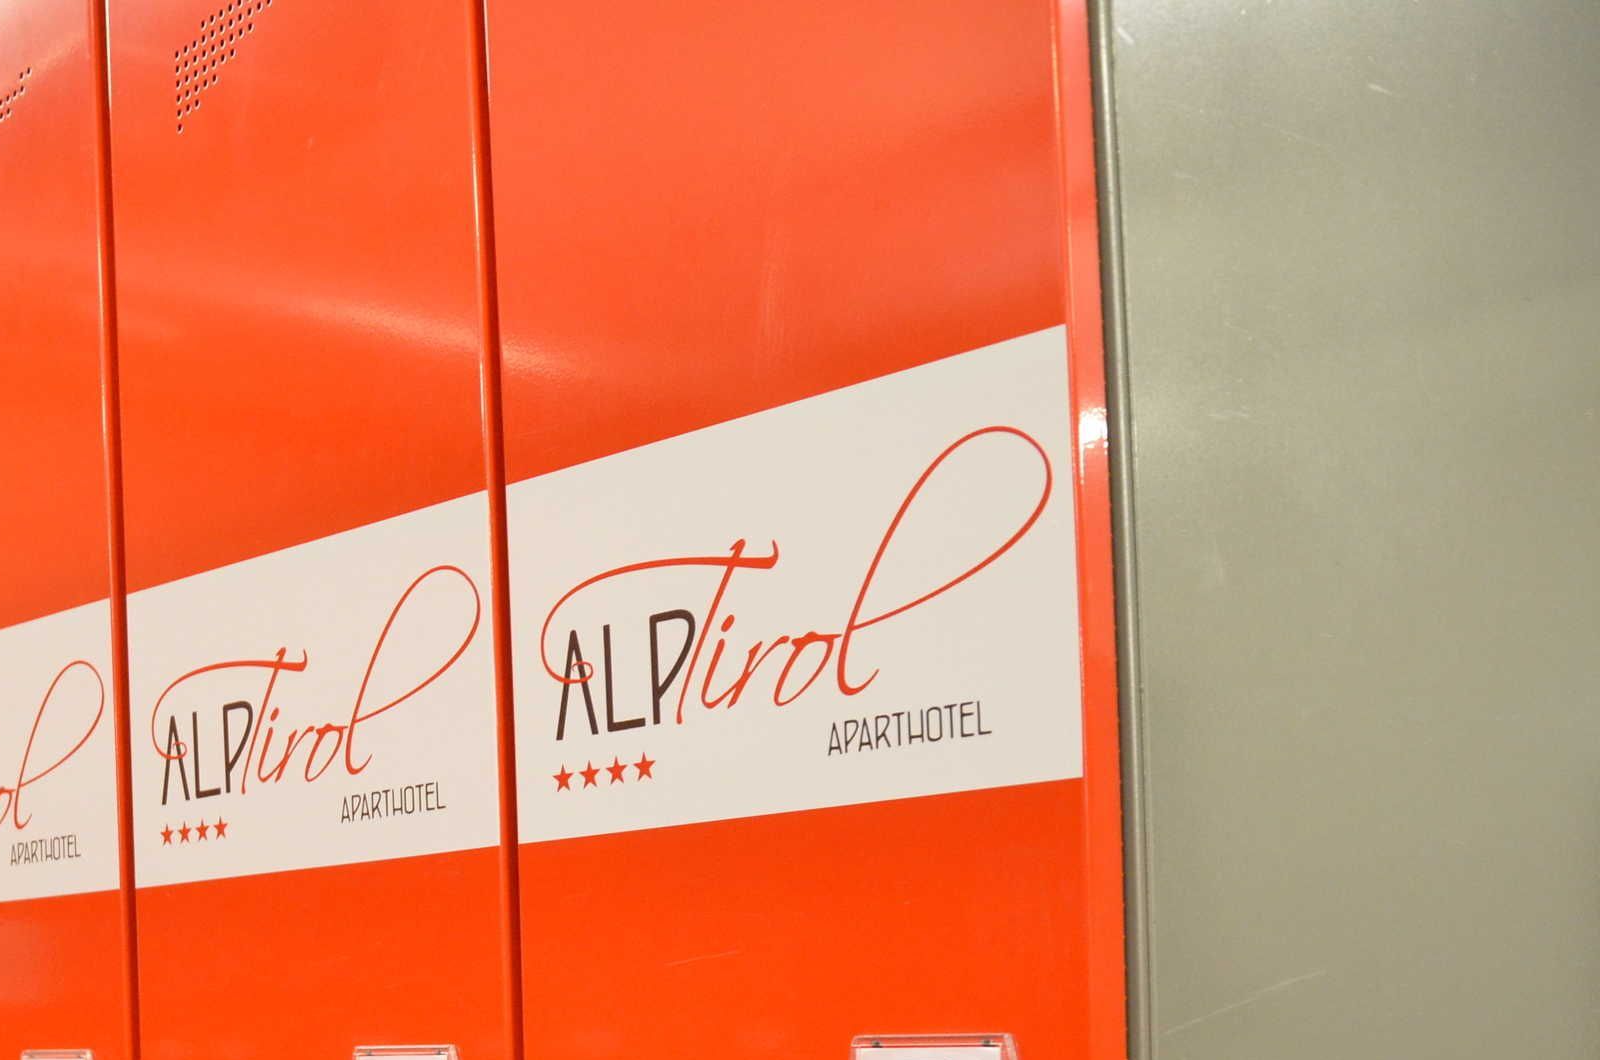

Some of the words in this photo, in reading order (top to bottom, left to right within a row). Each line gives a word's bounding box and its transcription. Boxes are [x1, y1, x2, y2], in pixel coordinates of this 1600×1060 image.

[827, 700, 992, 756] APARTHOTEL
[340, 781, 447, 824] APARTHOTEL
[10, 834, 81, 867] APARTHOTEL
